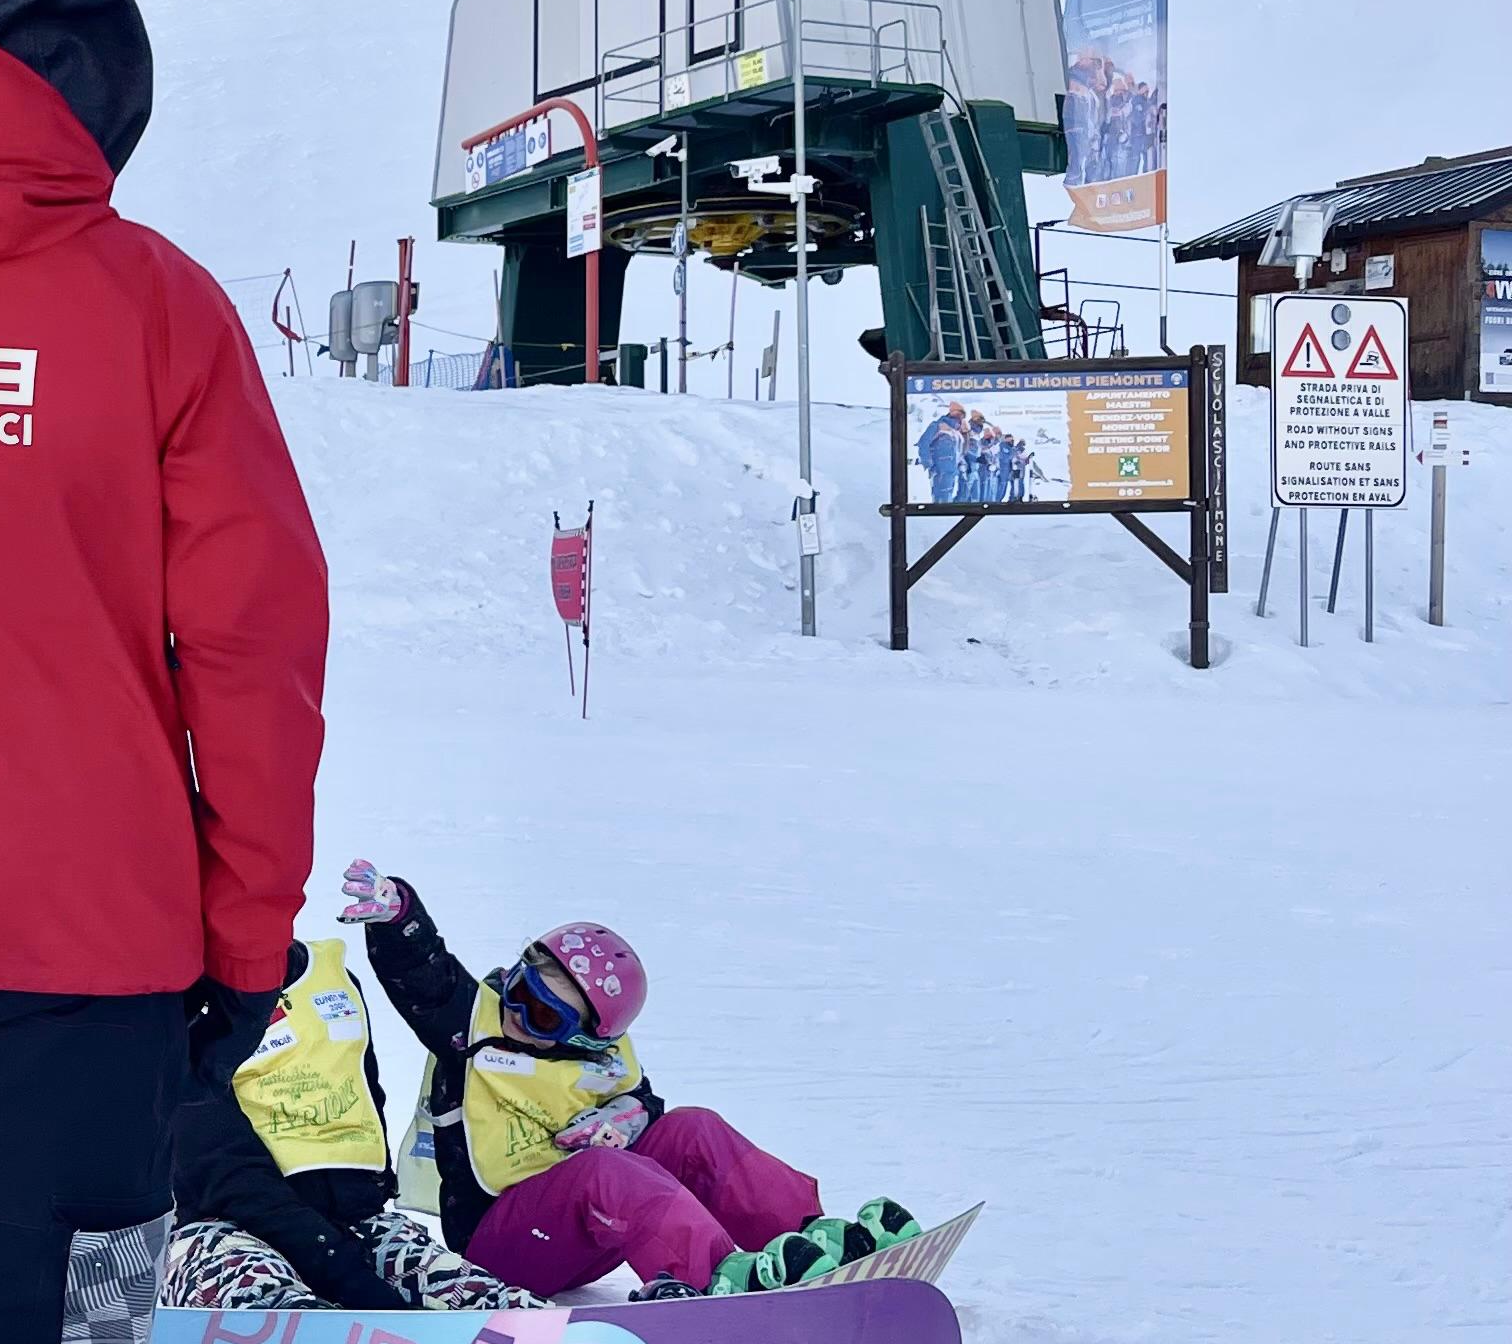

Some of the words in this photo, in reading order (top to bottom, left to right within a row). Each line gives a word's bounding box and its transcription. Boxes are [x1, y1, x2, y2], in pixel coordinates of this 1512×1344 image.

[931, 378, 993, 390] SCUOLA
[996, 377, 1020, 389] SCI
[1023, 376, 1082, 388] LIMONE
[1086, 374, 1164, 387] PIEMONTE
[1300, 382, 1338, 393] STRADA
[1340, 384, 1368, 394] PRIVA
[1371, 384, 1381, 394] DI
[1086, 390, 1171, 400] APPUNTAMENTO
[1296, 394, 1363, 405] SEGNALETICA
[1365, 396, 1372, 405] E
[1374, 396, 1385, 406] DI
[1105, 400, 1151, 409] MAESTRI
[1092, 413, 1165, 422] RENDEZ-VOUS
[1289, 406, 1350, 417] PROTEZIONE
[1352, 408, 1360, 417] A
[1362, 408, 1391, 418] VALLE
[1101, 423, 1156, 432] MONITEUR
[1286, 425, 1314, 435] ROAD
[1316, 426, 1360, 436] WITHOUT
[1362, 426, 1393, 436] SIGNS
[1090, 436, 1135, 444] MEETING
[1136, 435, 1168, 443] POINT
[1284, 439, 1305, 449] AND
[1308, 440, 1366, 450] PROTECTIVE
[1368, 441, 1396, 451] RAILS
[1106, 445, 1170, 454] INSTRUCTOR
[1309, 461, 1341, 471] ROUTE
[1344, 462, 1371, 472] SANS
[1281, 475, 1356, 486] SIGNALISATION
[1359, 477, 1370, 487] ET
[1373, 477, 1399, 487] SANS
[1288, 491, 1349, 501] PROTECTION
[1352, 492, 1366, 502] EN
[1368, 492, 1392, 502] AVAL
[484, 1054, 517, 1066] LUCIA
